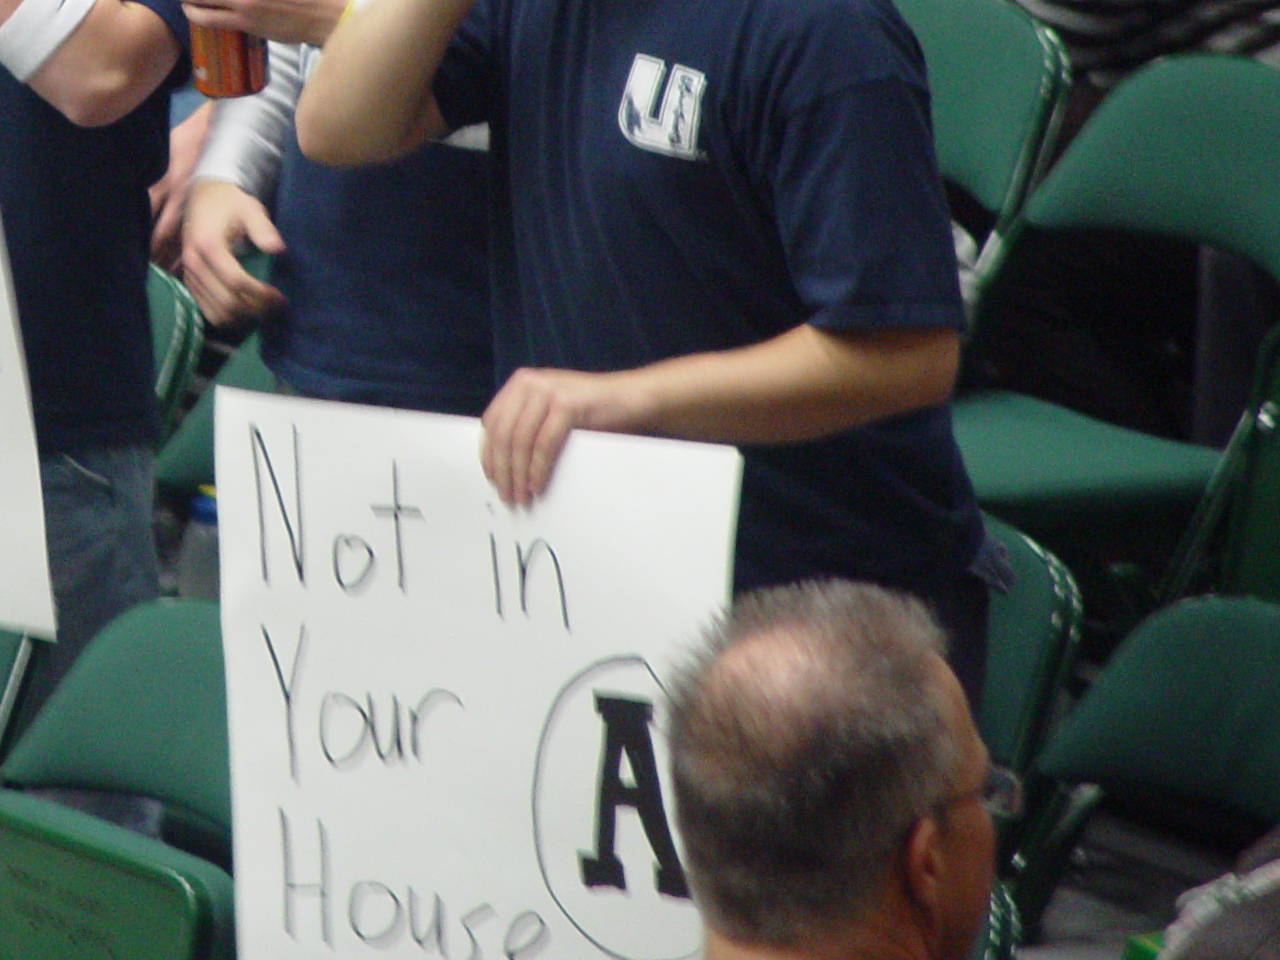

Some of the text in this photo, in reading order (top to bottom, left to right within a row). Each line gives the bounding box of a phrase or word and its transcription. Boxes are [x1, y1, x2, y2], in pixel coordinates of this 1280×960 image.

[249, 422, 572, 634] Not in
[260, 620, 466, 786] Your
[577, 690, 693, 900] A
[278, 806, 550, 960] House
